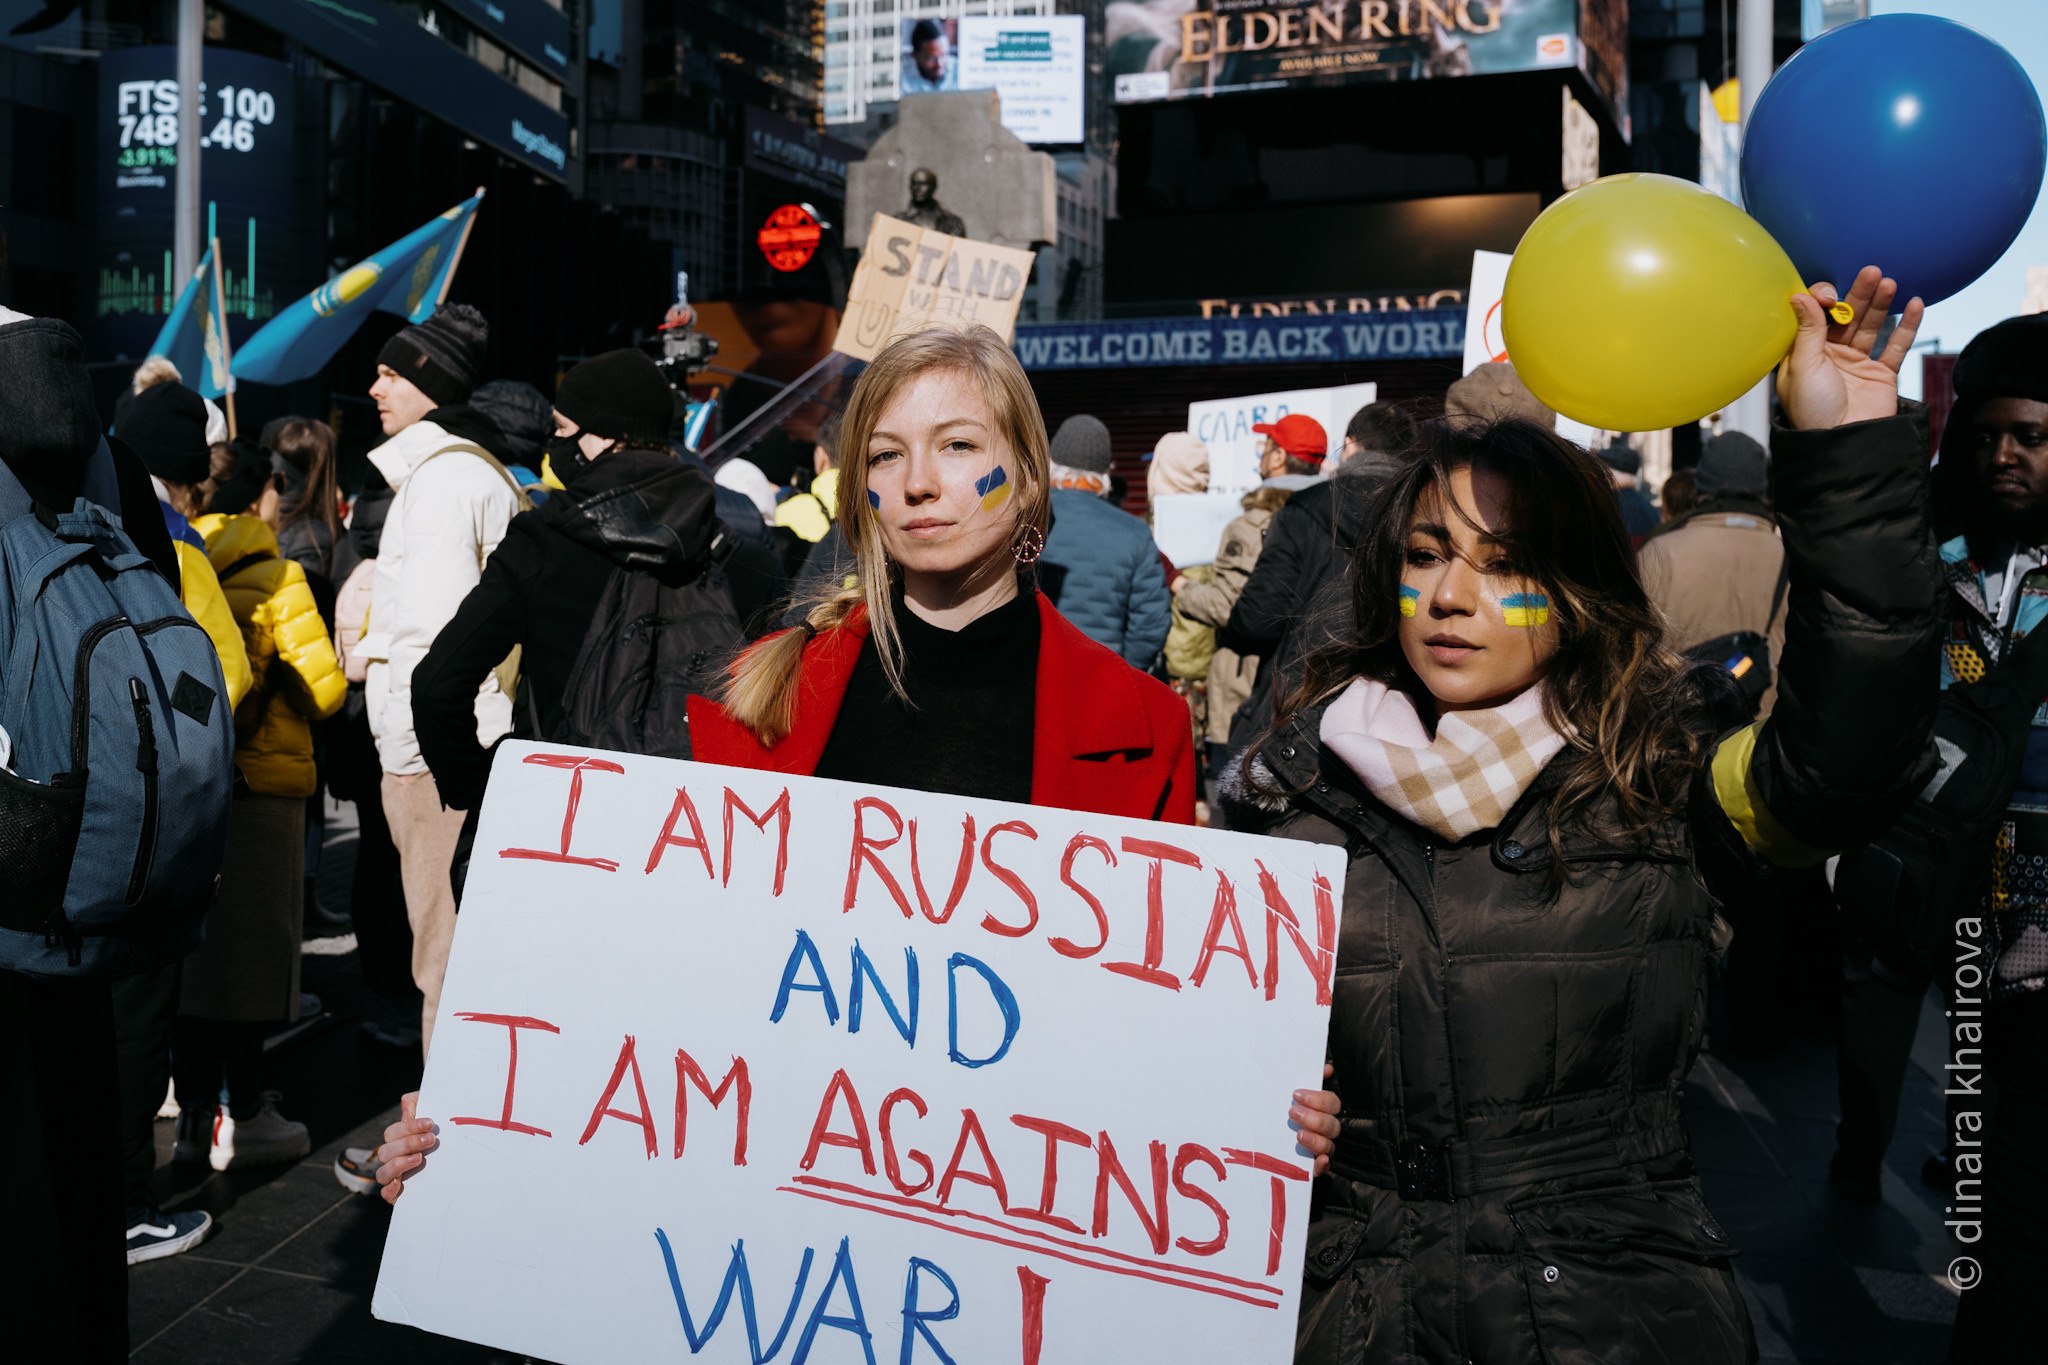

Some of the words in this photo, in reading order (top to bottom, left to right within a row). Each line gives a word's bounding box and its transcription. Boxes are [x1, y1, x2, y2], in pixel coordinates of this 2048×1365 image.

[1181, 6, 1344, 62] ELDEN
[1359, 0, 1501, 40] RING
[1278, 54, 1342, 71] AVAILABLE
[1344, 51, 1379, 65] NOW
[117, 114, 255, 152] 748.46
[217, 85, 276, 126] 100
[881, 236, 1022, 301] STAND
[1017, 330, 1212, 365] WELCOME
[1222, 326, 1334, 360] BACK
[1342, 321, 1465, 356] WORL
[499, 753, 625, 872] I
[645, 785, 791, 898] AM
[843, 796, 1336, 1007] RUSSIAN
[769, 928, 1021, 1069] AND
[449, 1012, 560, 1138] I
[578, 1034, 752, 1167] AM
[800, 1068, 1309, 1276] AGAINST
[654, 1227, 1051, 1365] WAR!
